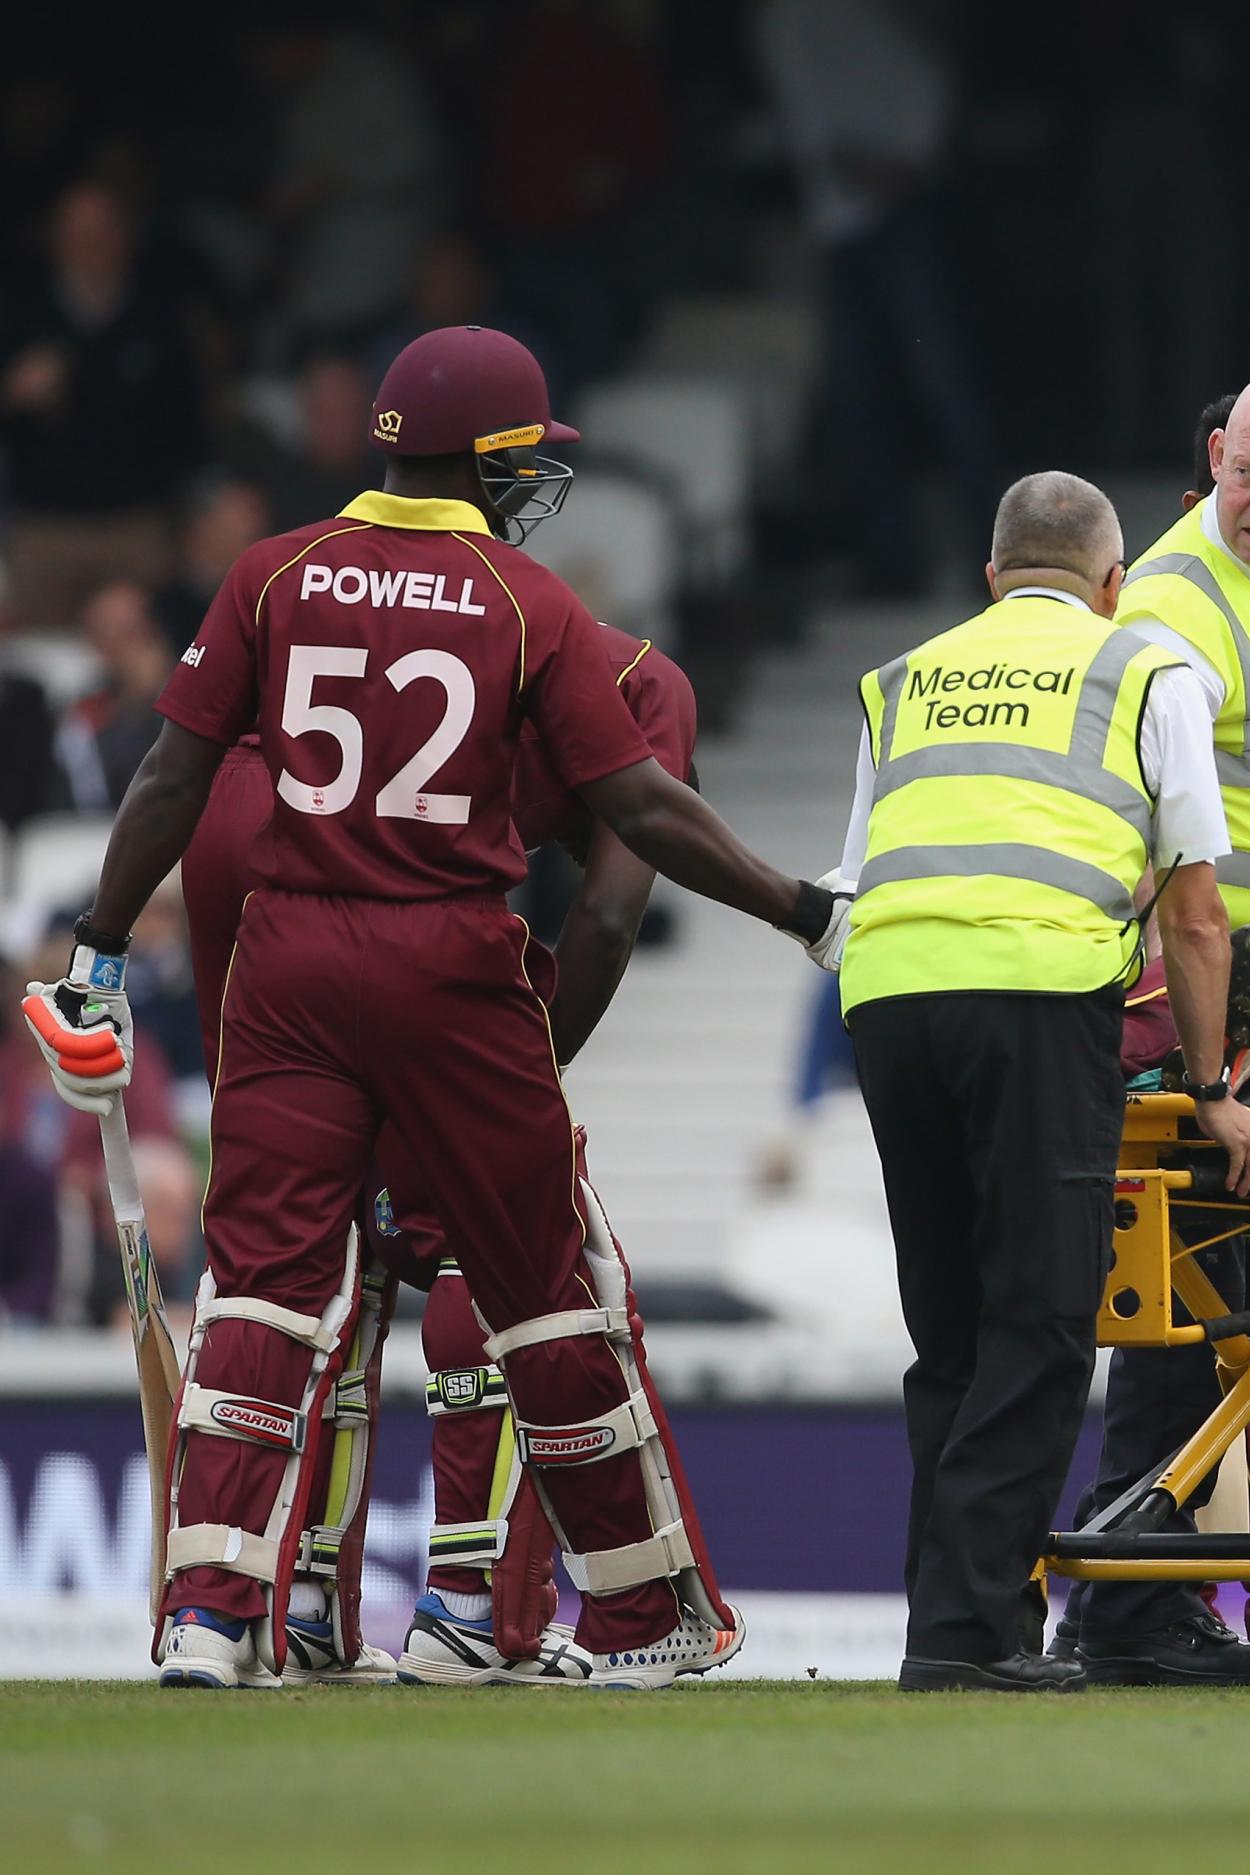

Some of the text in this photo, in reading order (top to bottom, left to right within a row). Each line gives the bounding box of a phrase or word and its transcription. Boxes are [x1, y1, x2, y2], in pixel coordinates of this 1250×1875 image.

[498, 430, 535, 444] MASURI
[300, 564, 486, 616] POWELL
[908, 664, 1075, 700] Medical
[925, 700, 1030, 731] Team
[276, 644, 475, 825] 52
[447, 1375, 474, 1397] SS
[217, 1407, 288, 1433] SPARTAN
[532, 1433, 604, 1453] SPARTAN
